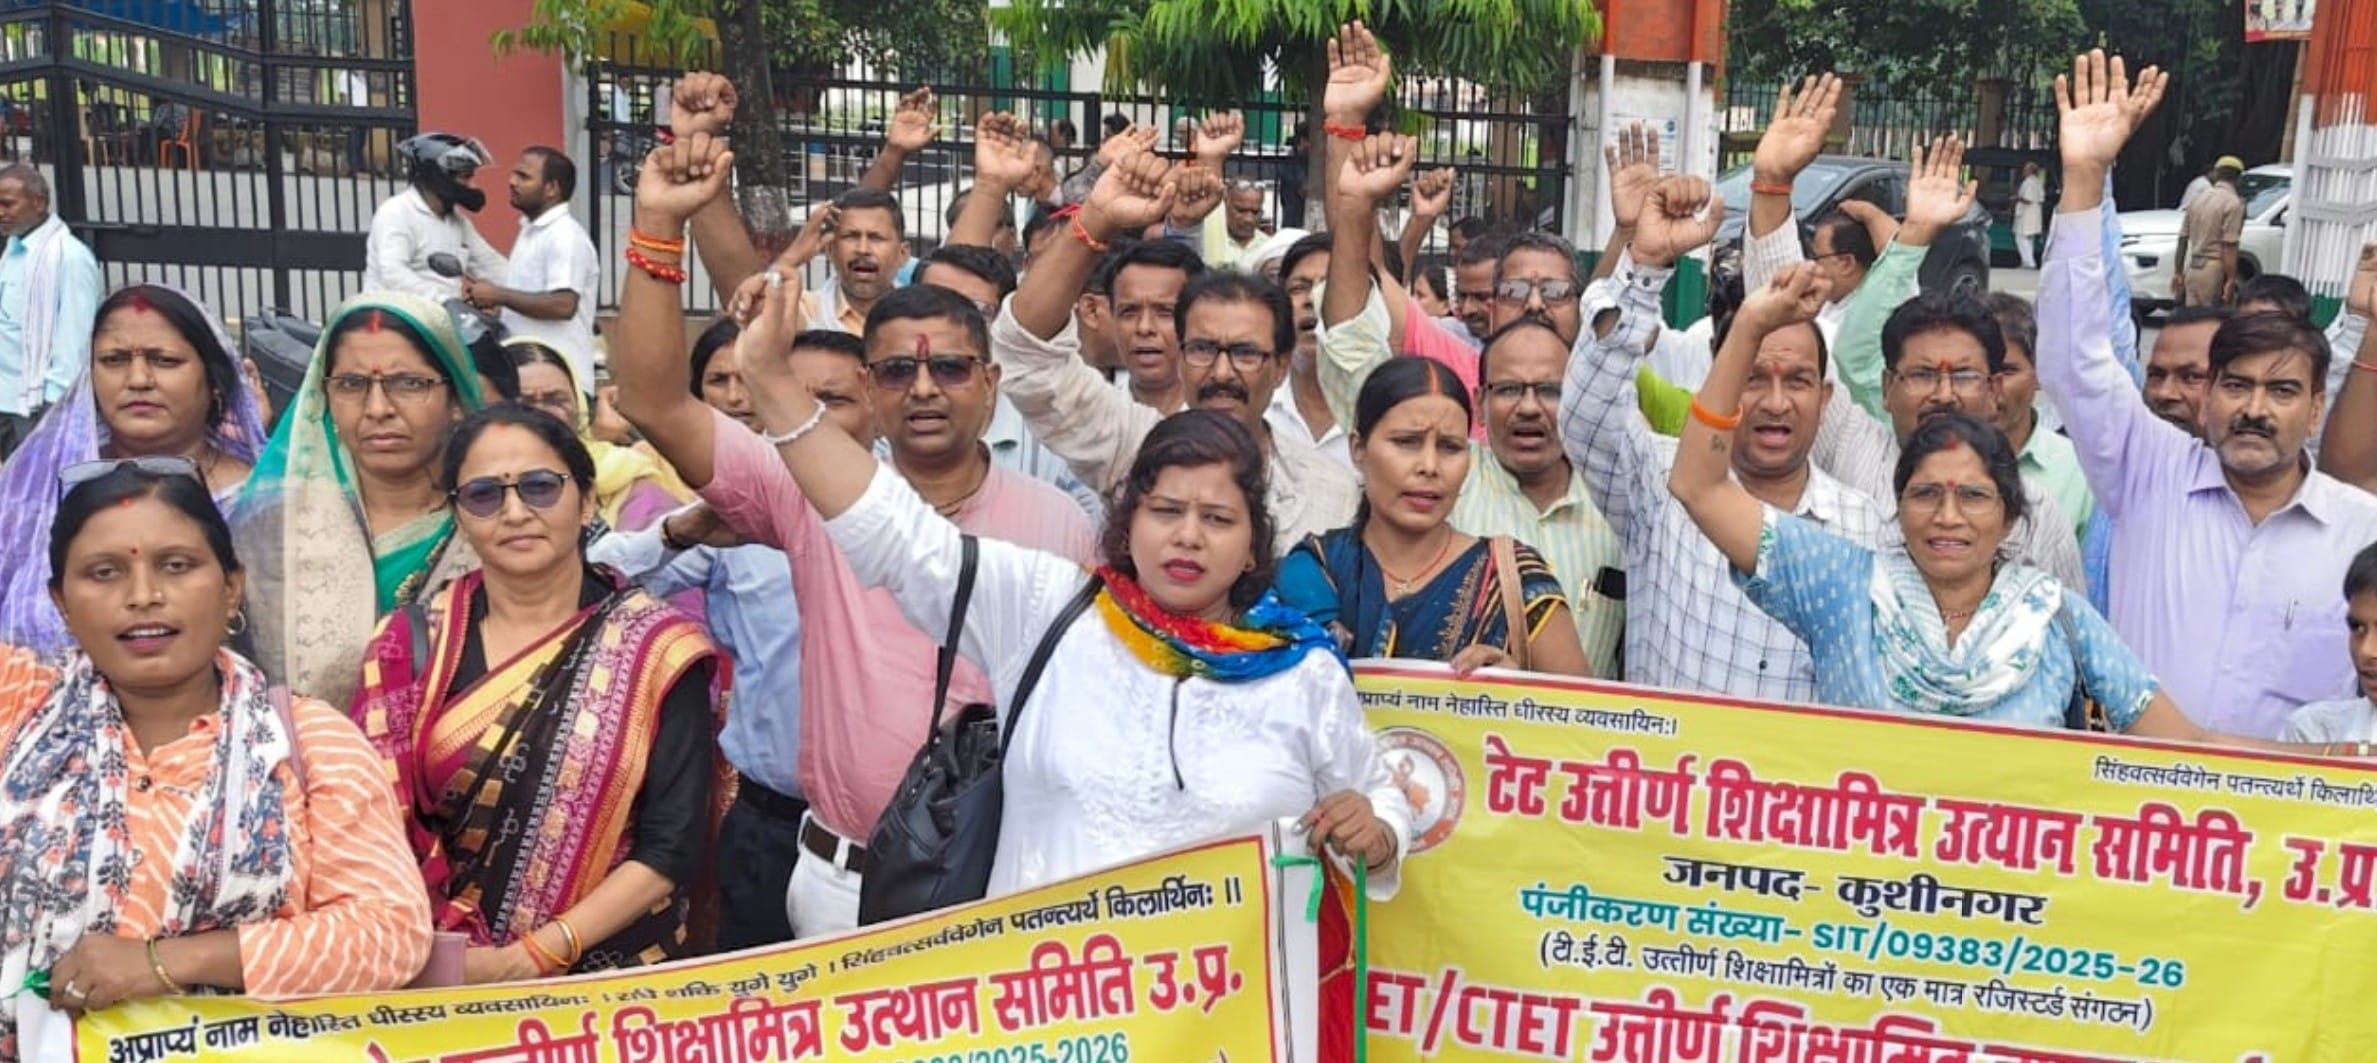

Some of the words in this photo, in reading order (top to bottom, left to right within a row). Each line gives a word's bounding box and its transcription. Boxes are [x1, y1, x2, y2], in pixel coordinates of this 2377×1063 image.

[1356, 690, 1402, 708] प्राप्यं
[1406, 695, 1440, 711] नाम
[1445, 693, 1508, 718] नेहास्ति
[1514, 698, 1569, 724] धीरस्य
[1485, 735, 1552, 815] टेट
[1560, 749, 1697, 834] उत्तीर्ण
[1705, 759, 1927, 858] शिक्षामित्र
[1935, 798, 2084, 874] उत्थान
[2092, 803, 2262, 908] समिति,
[1520, 883, 1680, 931] पंजीकरण
[1686, 901, 1802, 943] संख्या-
[1813, 920, 2184, 987] SIT/09383/2025-26
[1662, 856, 1821, 901] जनपद-
[1837, 872, 2049, 925] कुशीनगर
[110, 1016, 199, 1063] अप्राप्यं
[204, 1016, 259, 1048] नाम
[267, 1011, 361, 1038] नेहास्ति
[728, 973, 770, 996] युगे
[777, 964, 818, 992] युगे
[834, 978, 980, 1052] उत्थान
[989, 934, 1134, 1031] समिति
[1144, 946, 1242, 1013] उ.प्र.
[1366, 969, 1581, 1057] ET/CTET
[1540, 931, 1633, 967] (टी.ई.टी.
[1642, 943, 1718, 978] उत्तीर्ण
[1724, 953, 1837, 990] शिक्षामित्रों
[1843, 970, 1873, 995] का
[1880, 975, 1917, 1001] एक
[1924, 979, 1966, 1005] मात्र
[1973, 979, 2066, 1016] रजिस्टर्ड
[2069, 991, 2152, 1030] संगठन)
